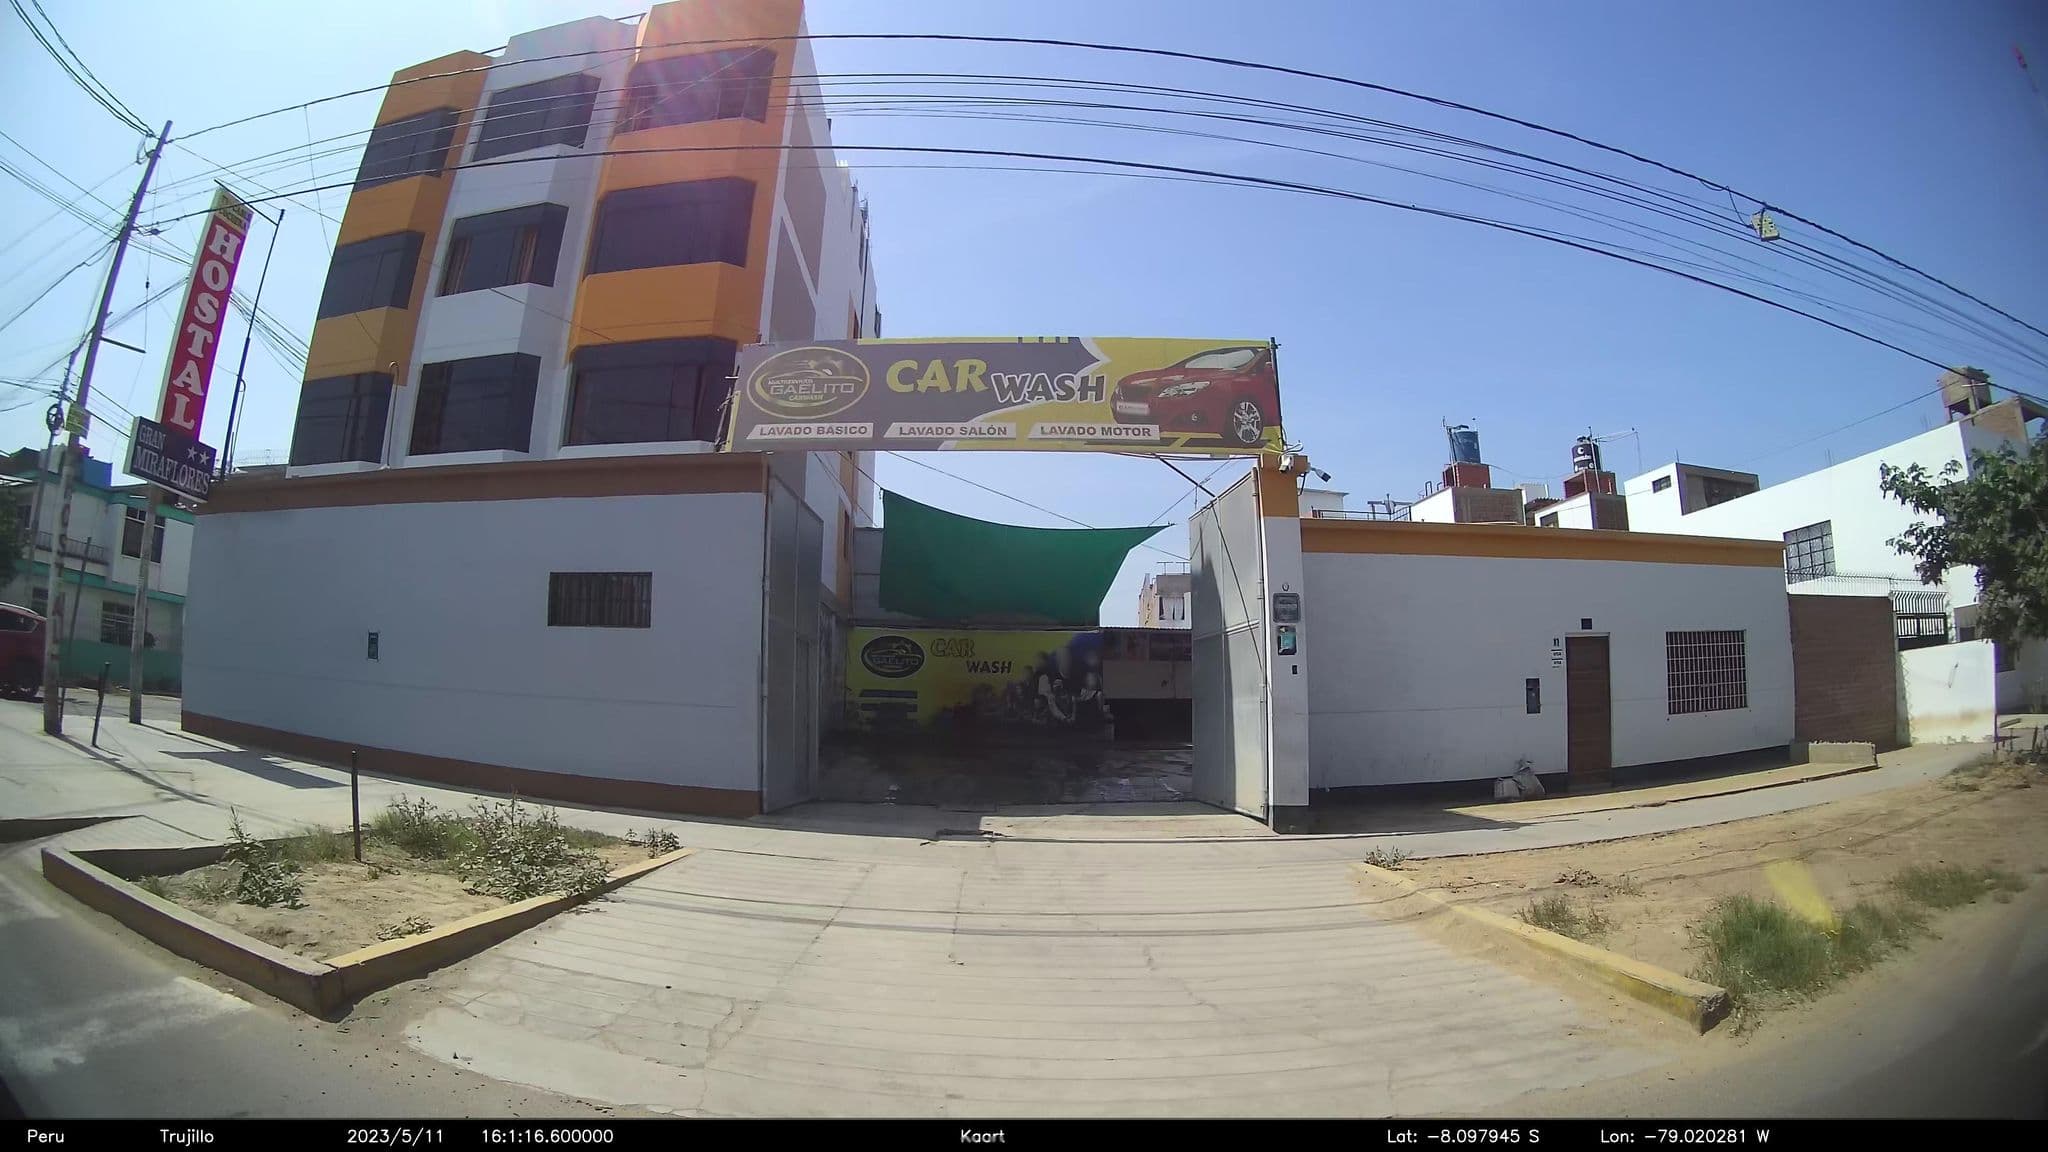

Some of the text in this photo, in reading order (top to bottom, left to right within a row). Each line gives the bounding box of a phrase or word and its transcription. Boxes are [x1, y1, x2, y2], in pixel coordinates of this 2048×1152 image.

[170, 225, 241, 430] HOSTAL
[771, 383, 855, 395] GAELITO
[886, 358, 1107, 404] CAR WASH
[138, 423, 167, 451] GRAN
[760, 426, 812, 436] LAVADO
[899, 424, 1007, 436] LAVADO SALÓN
[1040, 426, 1151, 437] LAVADO MOTOR
[133, 446, 212, 495] MIRAFLORES
[930, 638, 975, 658] CAR
[965, 660, 1013, 675] WASH
